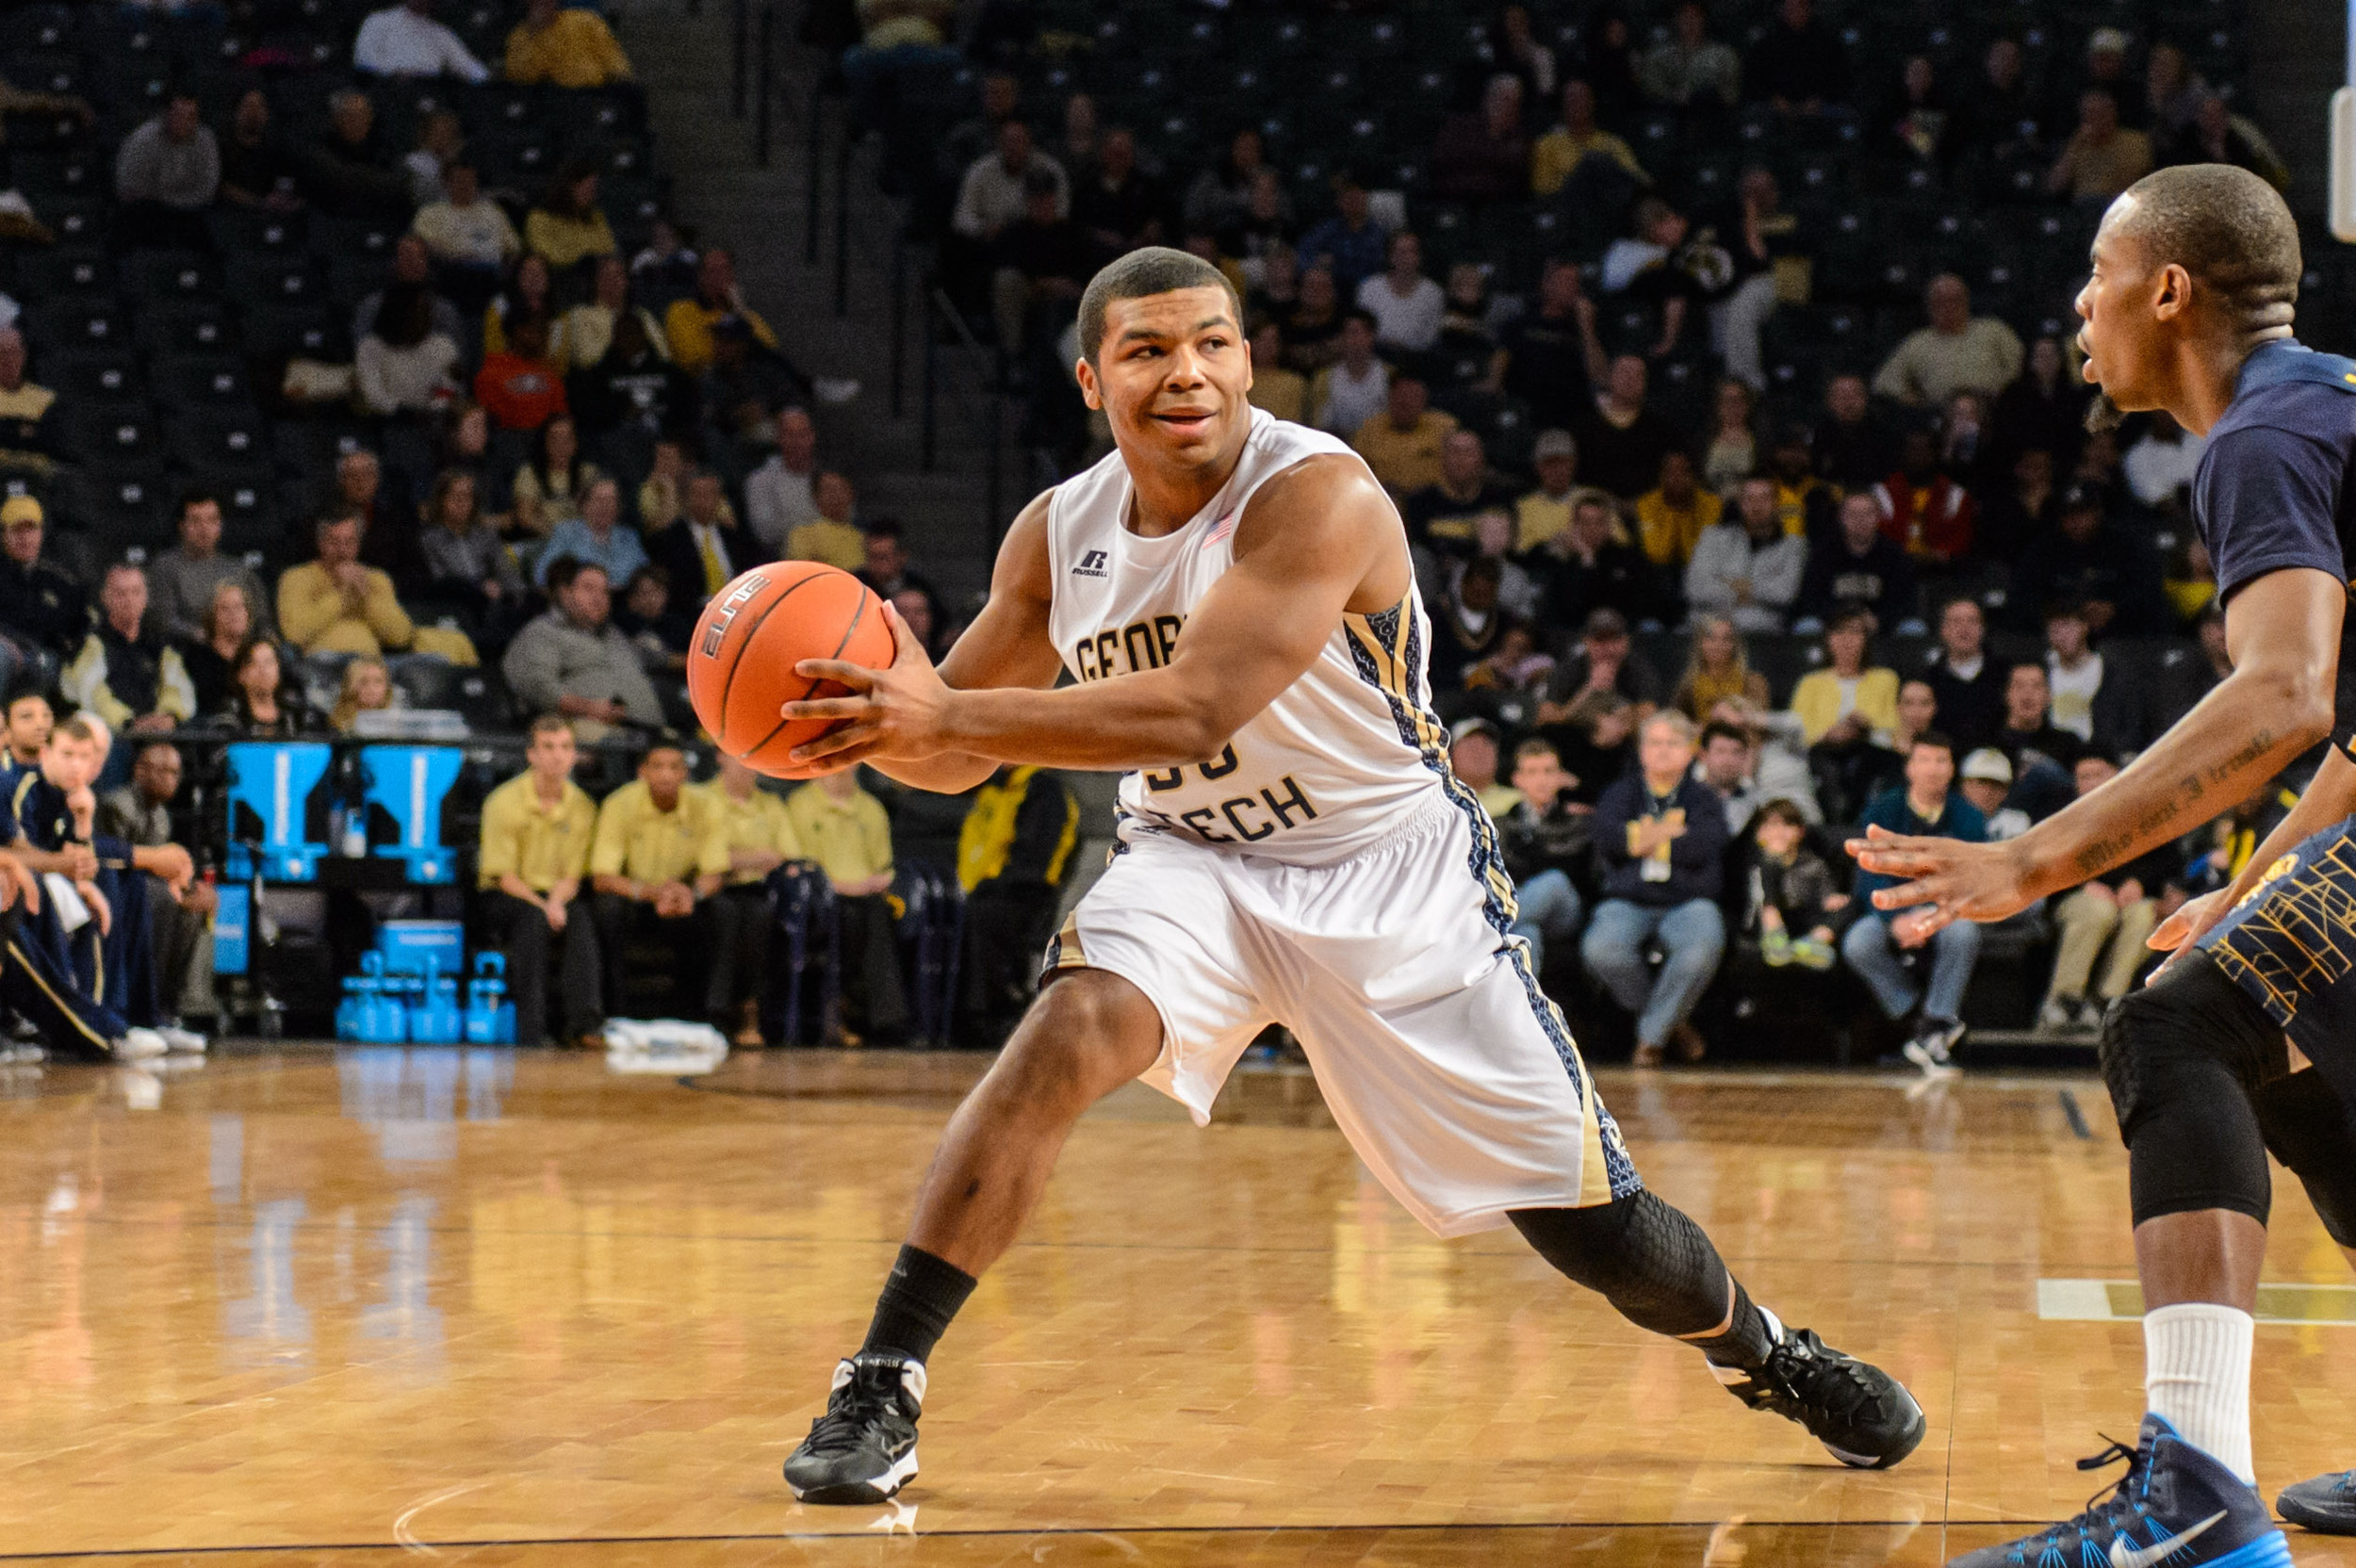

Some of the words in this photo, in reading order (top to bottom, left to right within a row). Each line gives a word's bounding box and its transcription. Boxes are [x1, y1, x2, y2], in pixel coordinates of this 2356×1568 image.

[1080, 549, 1108, 569] R
[1072, 567, 1108, 578] RUSSELL
[1075, 612, 1187, 683] GEOR
